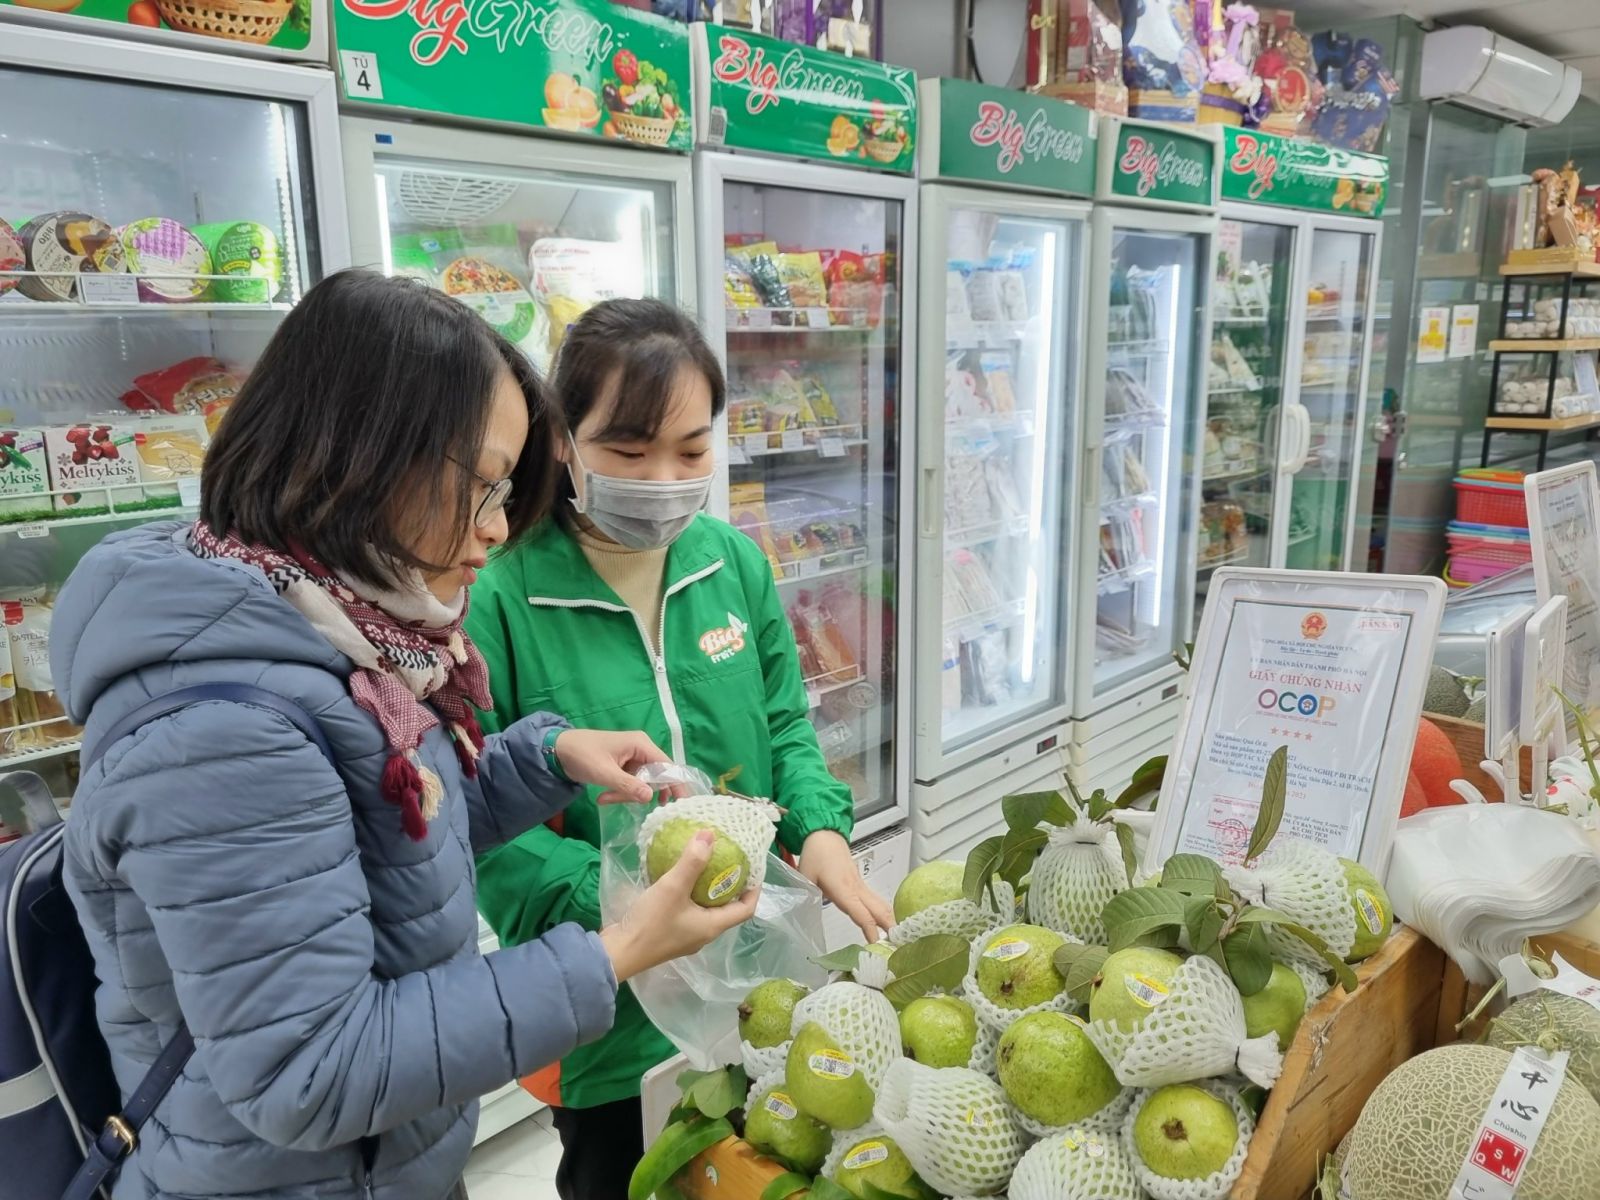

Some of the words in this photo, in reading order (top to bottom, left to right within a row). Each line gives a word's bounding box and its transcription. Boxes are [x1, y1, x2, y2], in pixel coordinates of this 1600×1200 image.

[357, 70, 371, 91] 4
[713, 36, 779, 115] Big
[779, 48, 865, 105] Green
[970, 101, 1024, 173] Big
[1023, 108, 1083, 163] Green
[1119, 136, 1158, 196] Big
[1157, 140, 1205, 187] Green
[1230, 134, 1277, 200] Big
[60, 463, 134, 480] Meltykiss
[699, 627, 745, 656] Big
[1249, 669, 1276, 683] GIẤY
[1279, 674, 1321, 690] CHỨNG
[1324, 679, 1363, 695] NHẬN
[1258, 689, 1337, 718] OCOP
[1484, 1131, 1495, 1144] H
[1513, 1146, 1522, 1158] T
[1493, 1148, 1504, 1160] S
[1475, 1152, 1486, 1165] Q
[1500, 1165, 1515, 1180] W
